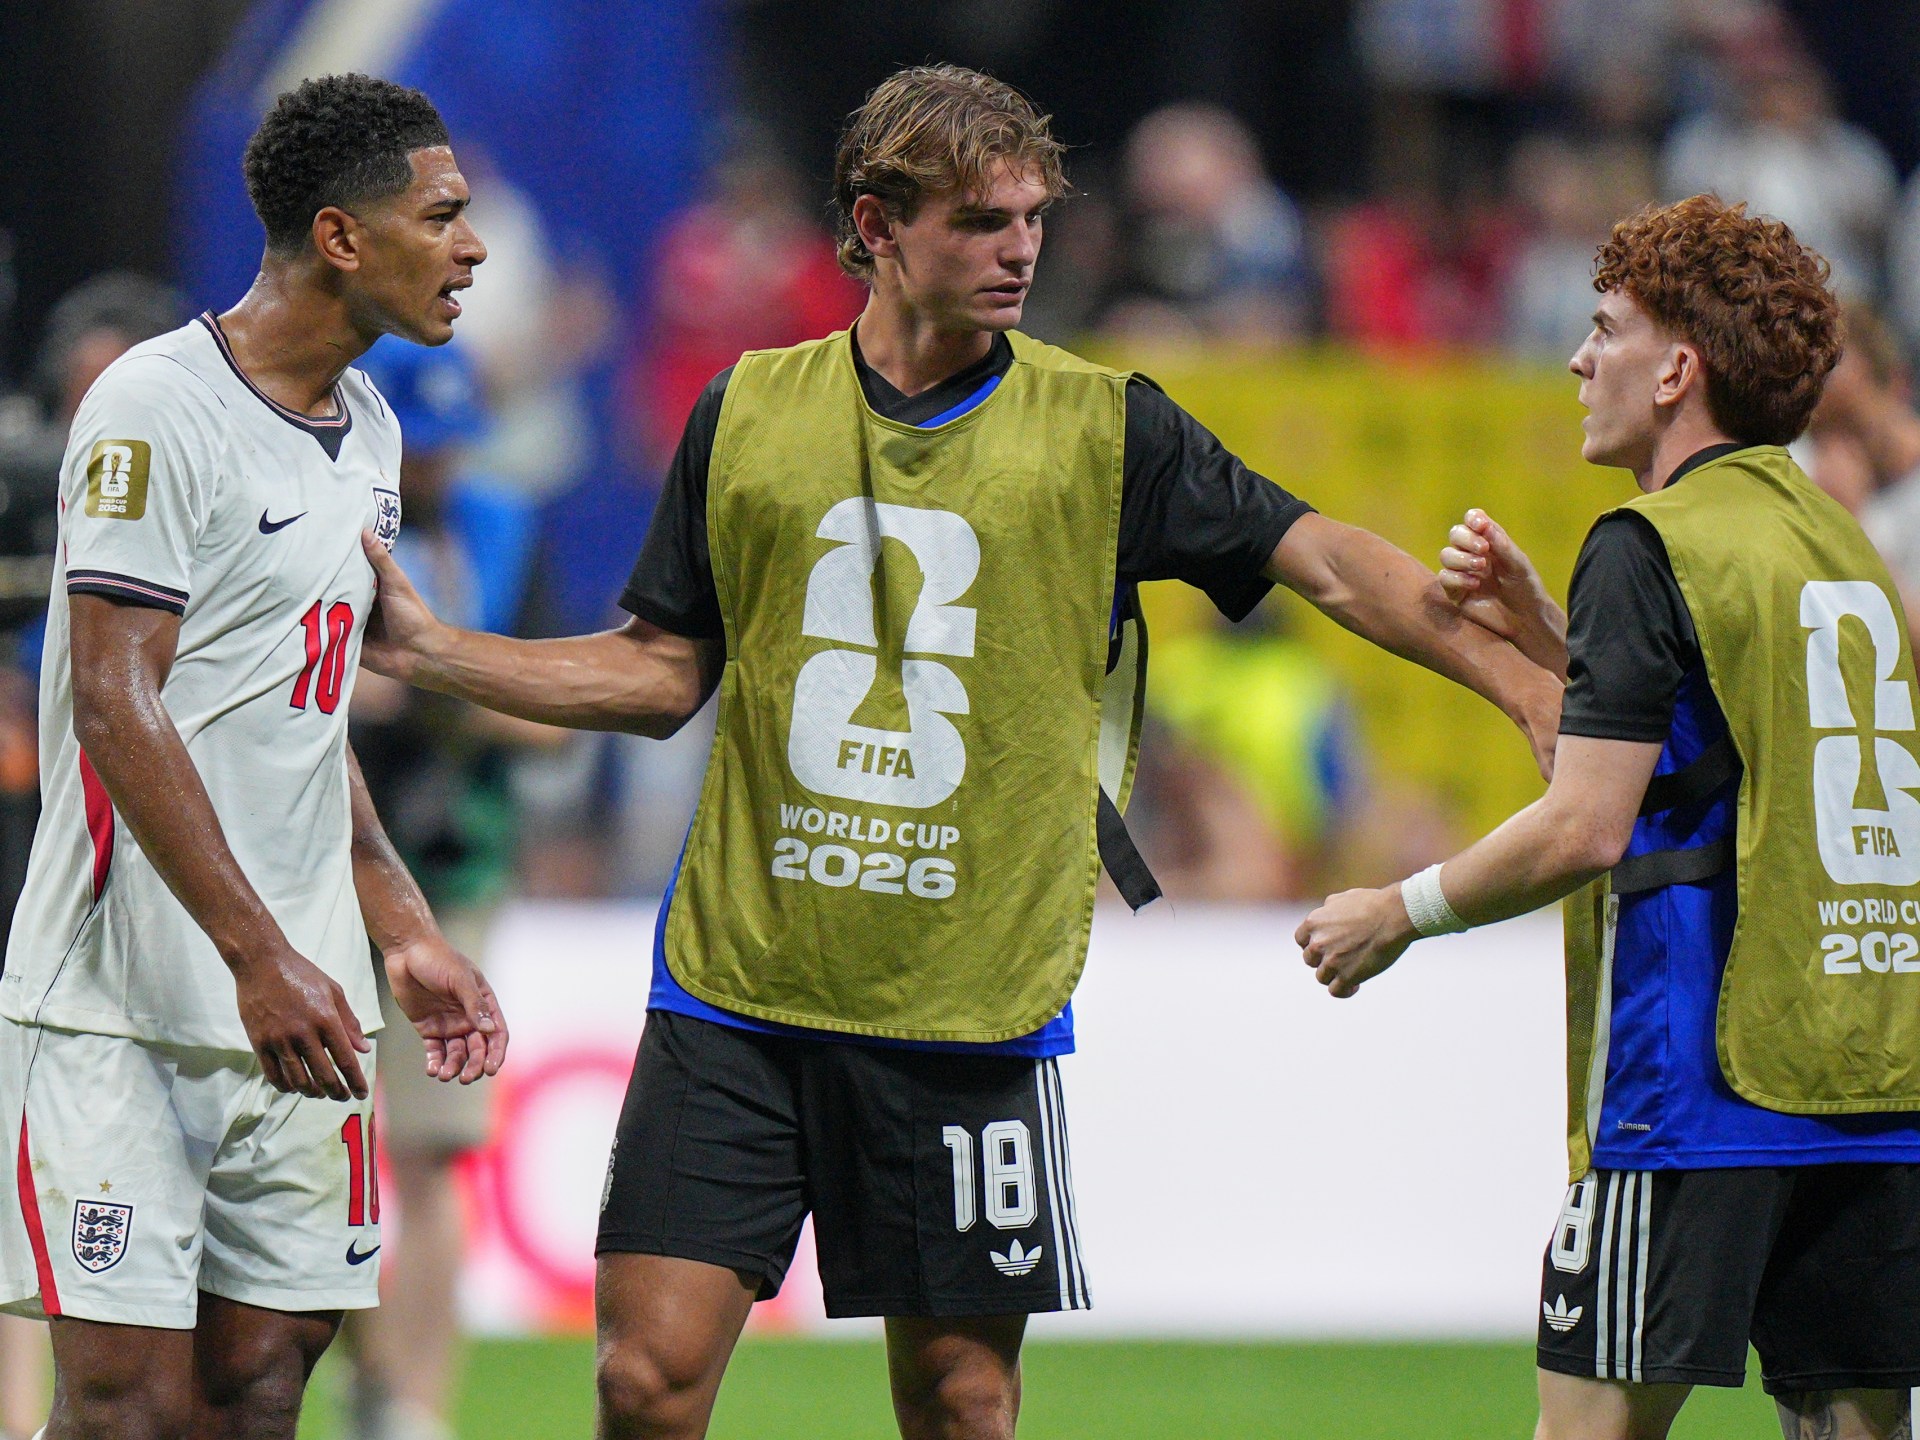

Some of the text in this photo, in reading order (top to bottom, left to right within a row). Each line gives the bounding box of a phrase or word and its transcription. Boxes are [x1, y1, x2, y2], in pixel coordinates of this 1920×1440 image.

[98, 504, 126, 513] 2026
[290, 600, 354, 715] 10
[837, 739, 916, 780] FIFA
[780, 803, 960, 850] WORLD CUP
[1851, 825, 1901, 857] FIFA
[771, 837, 956, 899] 2026
[1818, 898, 1897, 926] WORLD
[942, 1120, 1038, 1232] 18
